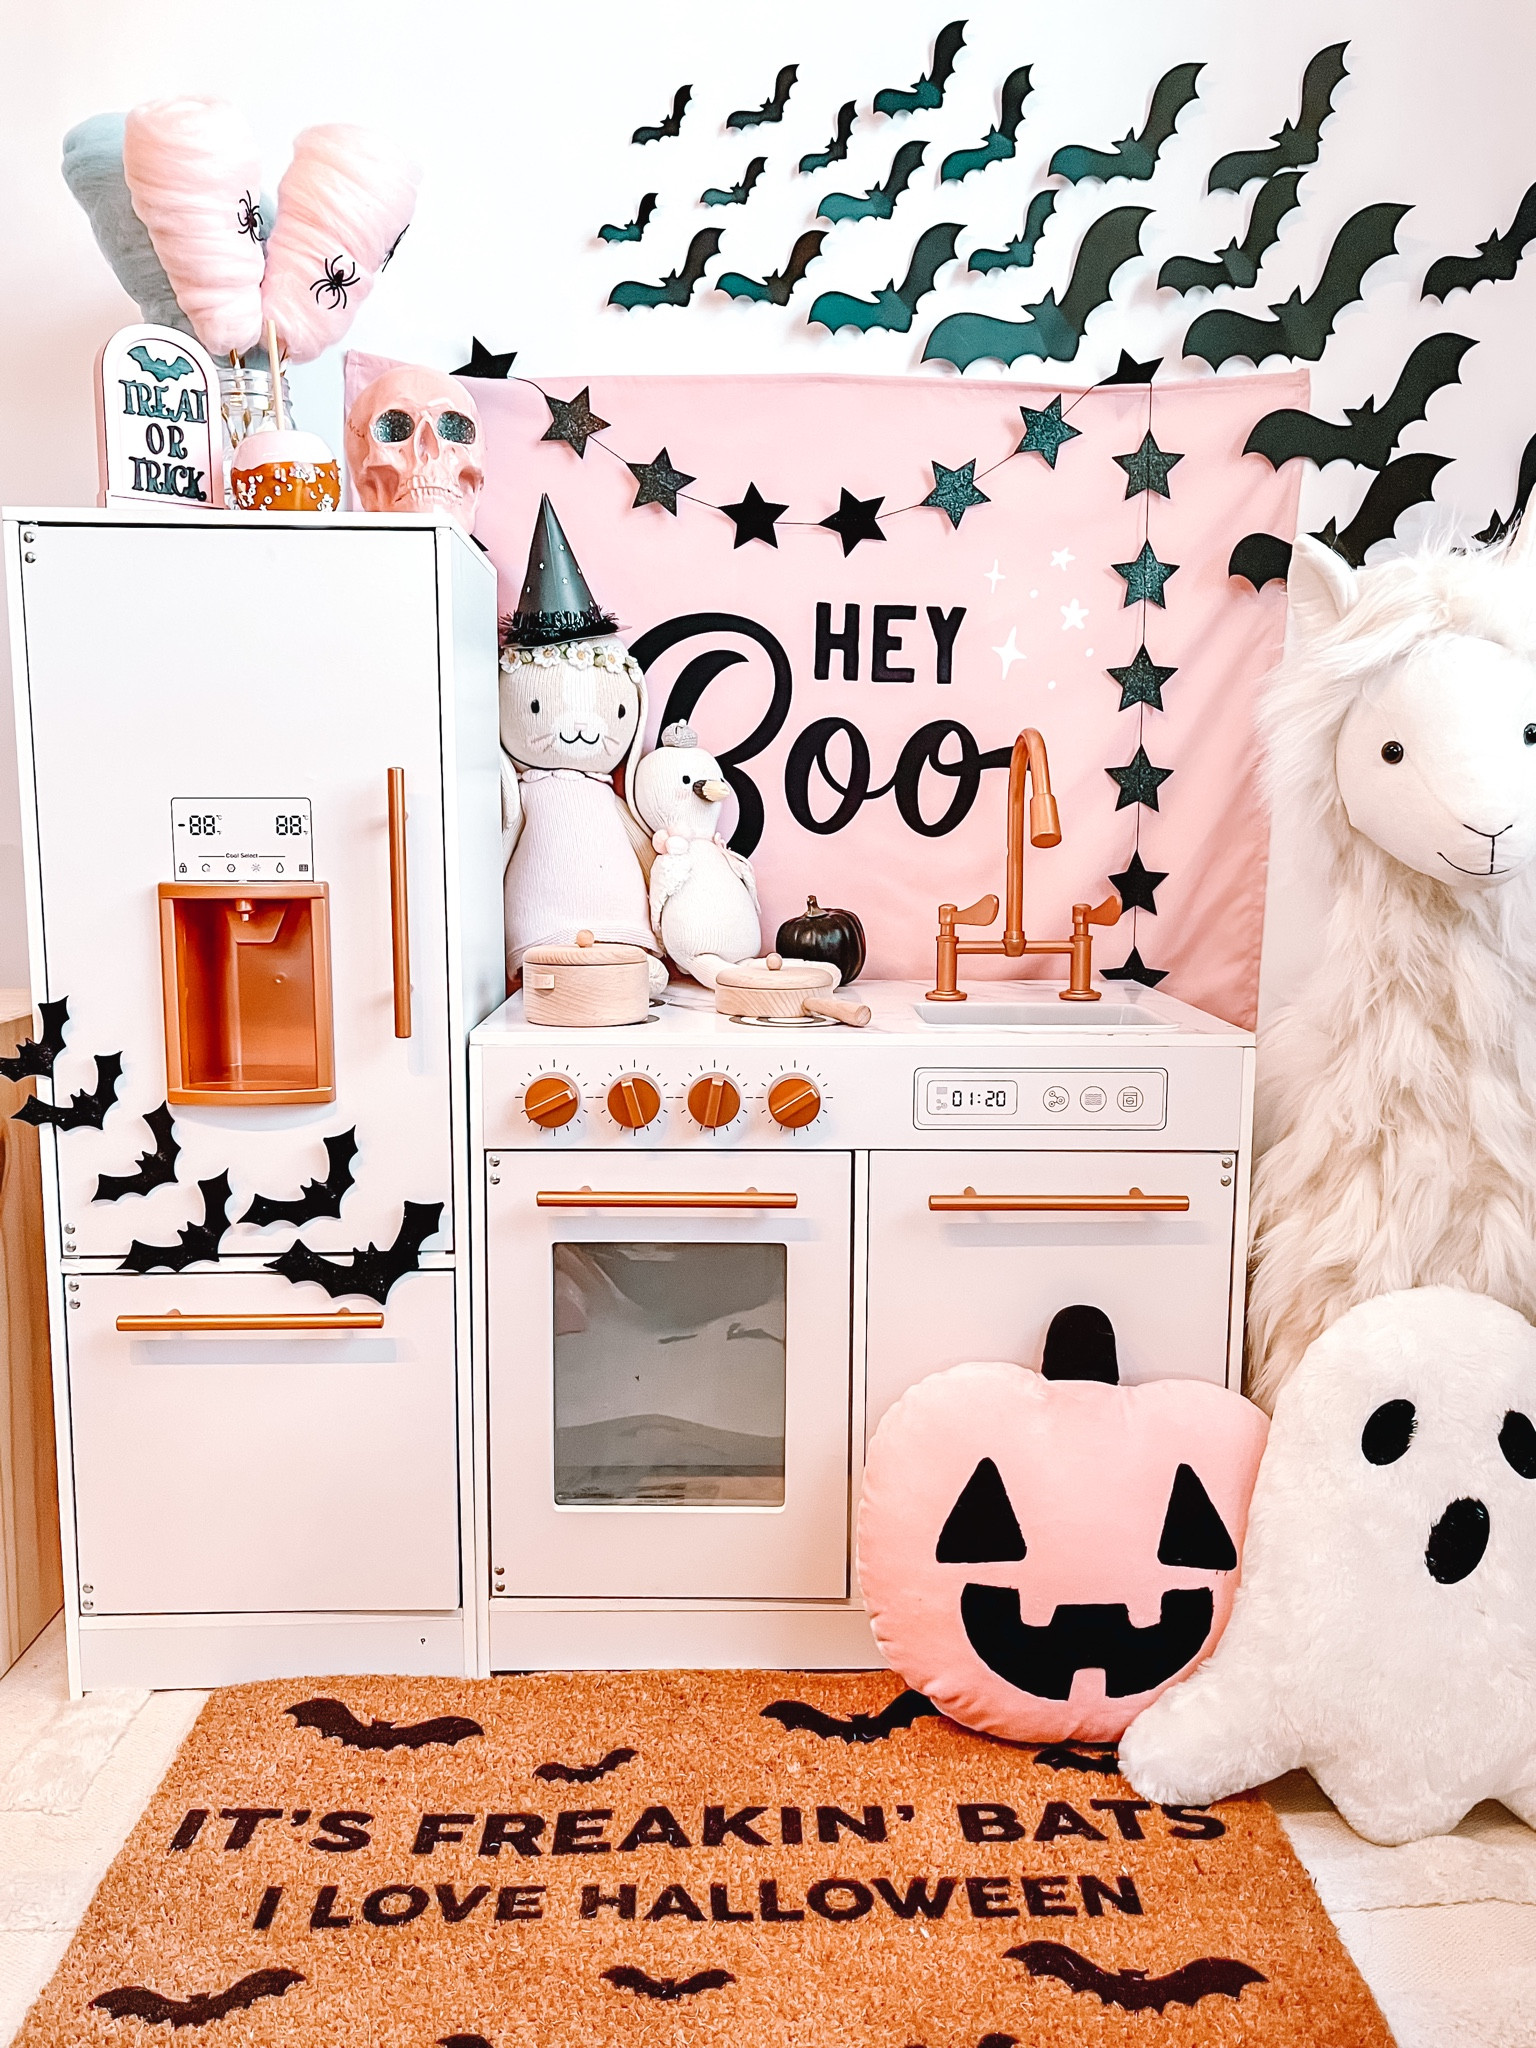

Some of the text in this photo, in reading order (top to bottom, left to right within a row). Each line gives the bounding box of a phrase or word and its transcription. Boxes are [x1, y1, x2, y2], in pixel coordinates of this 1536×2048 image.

[118, 379, 207, 423] TREAT
[146, 423, 188, 459] OR
[814, 602, 967, 684] HEY
[628, 612, 1031, 859] Boo
[952, 1091, 1006, 1107] 01:20
[168, 1799, 1226, 1856] IT'S FREAKIN' BATS
[252, 1876, 1143, 1931] I LOVE HALLOWEEN
